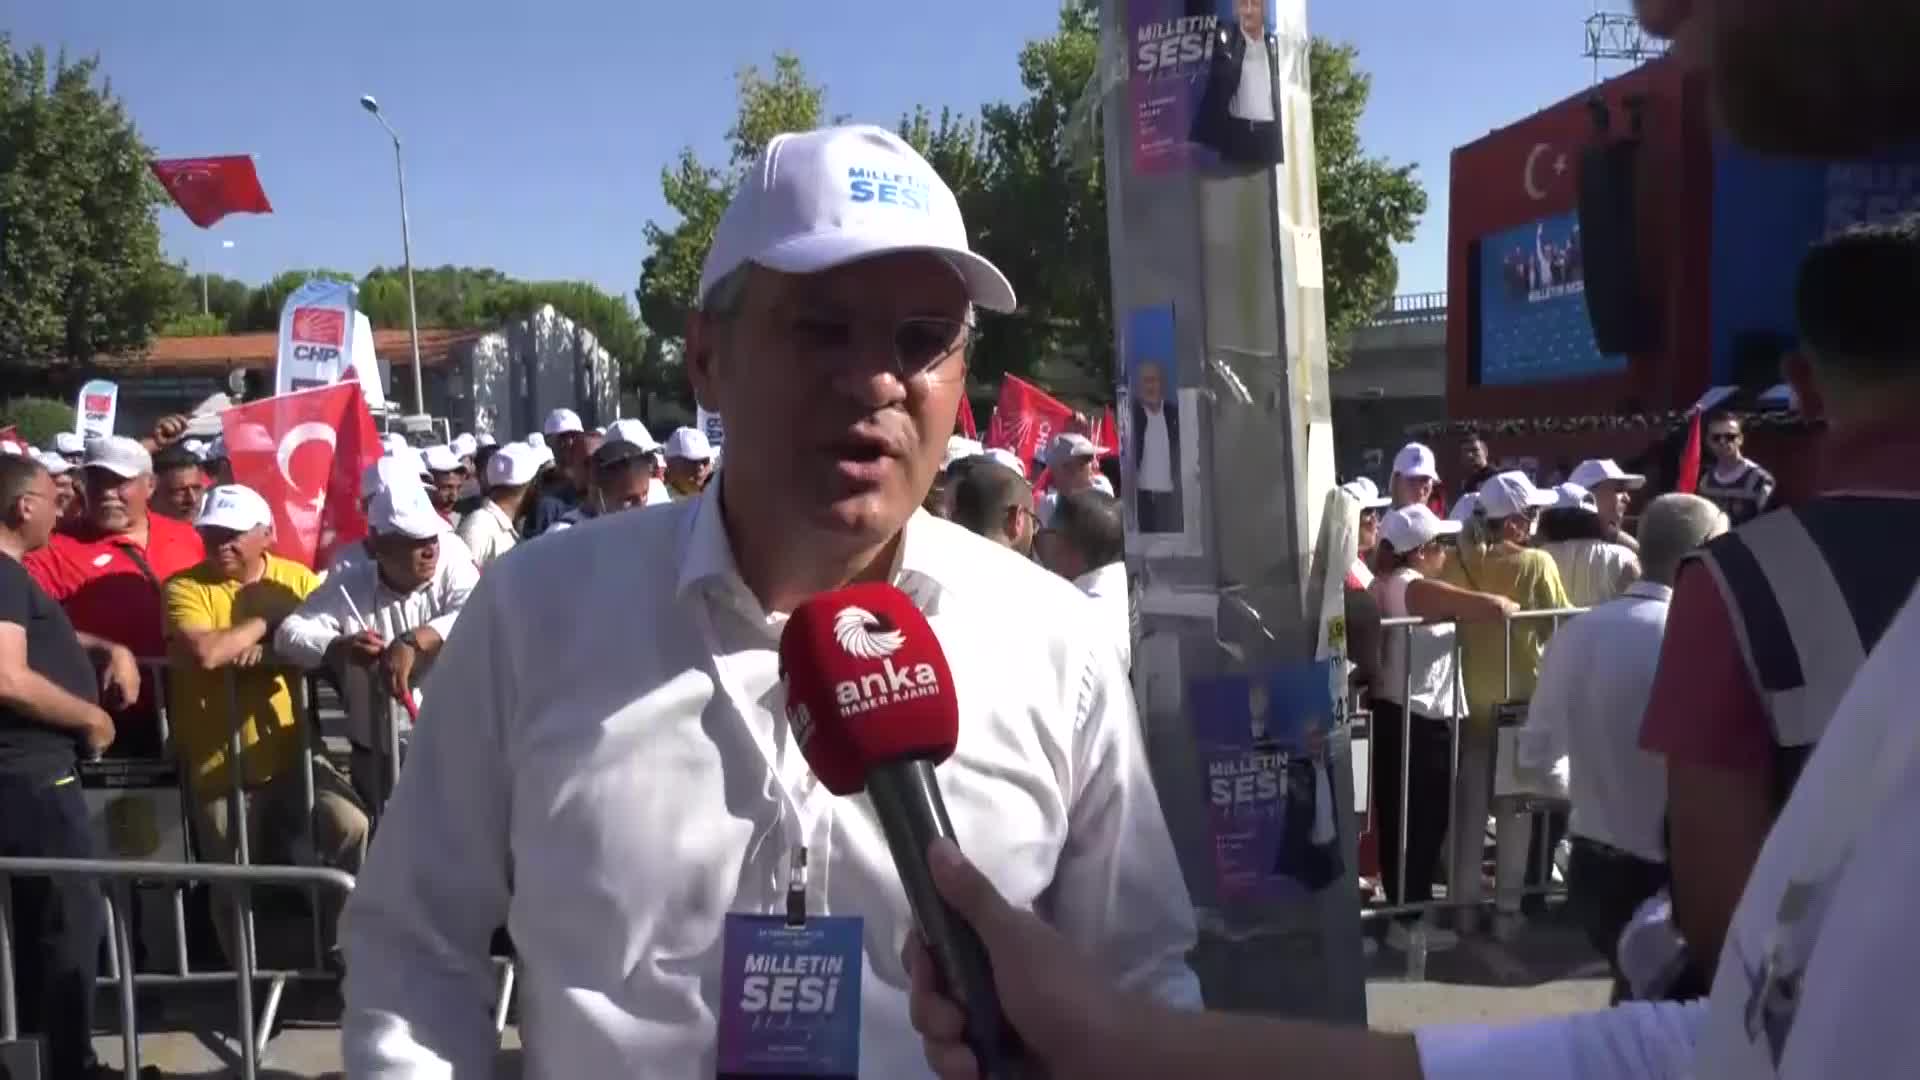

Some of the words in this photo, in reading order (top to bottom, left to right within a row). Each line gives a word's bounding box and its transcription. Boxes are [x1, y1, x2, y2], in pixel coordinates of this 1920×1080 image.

[294, 345, 338, 362] CHP
[836, 658, 937, 705] anka
[840, 697, 889, 718] HABER
